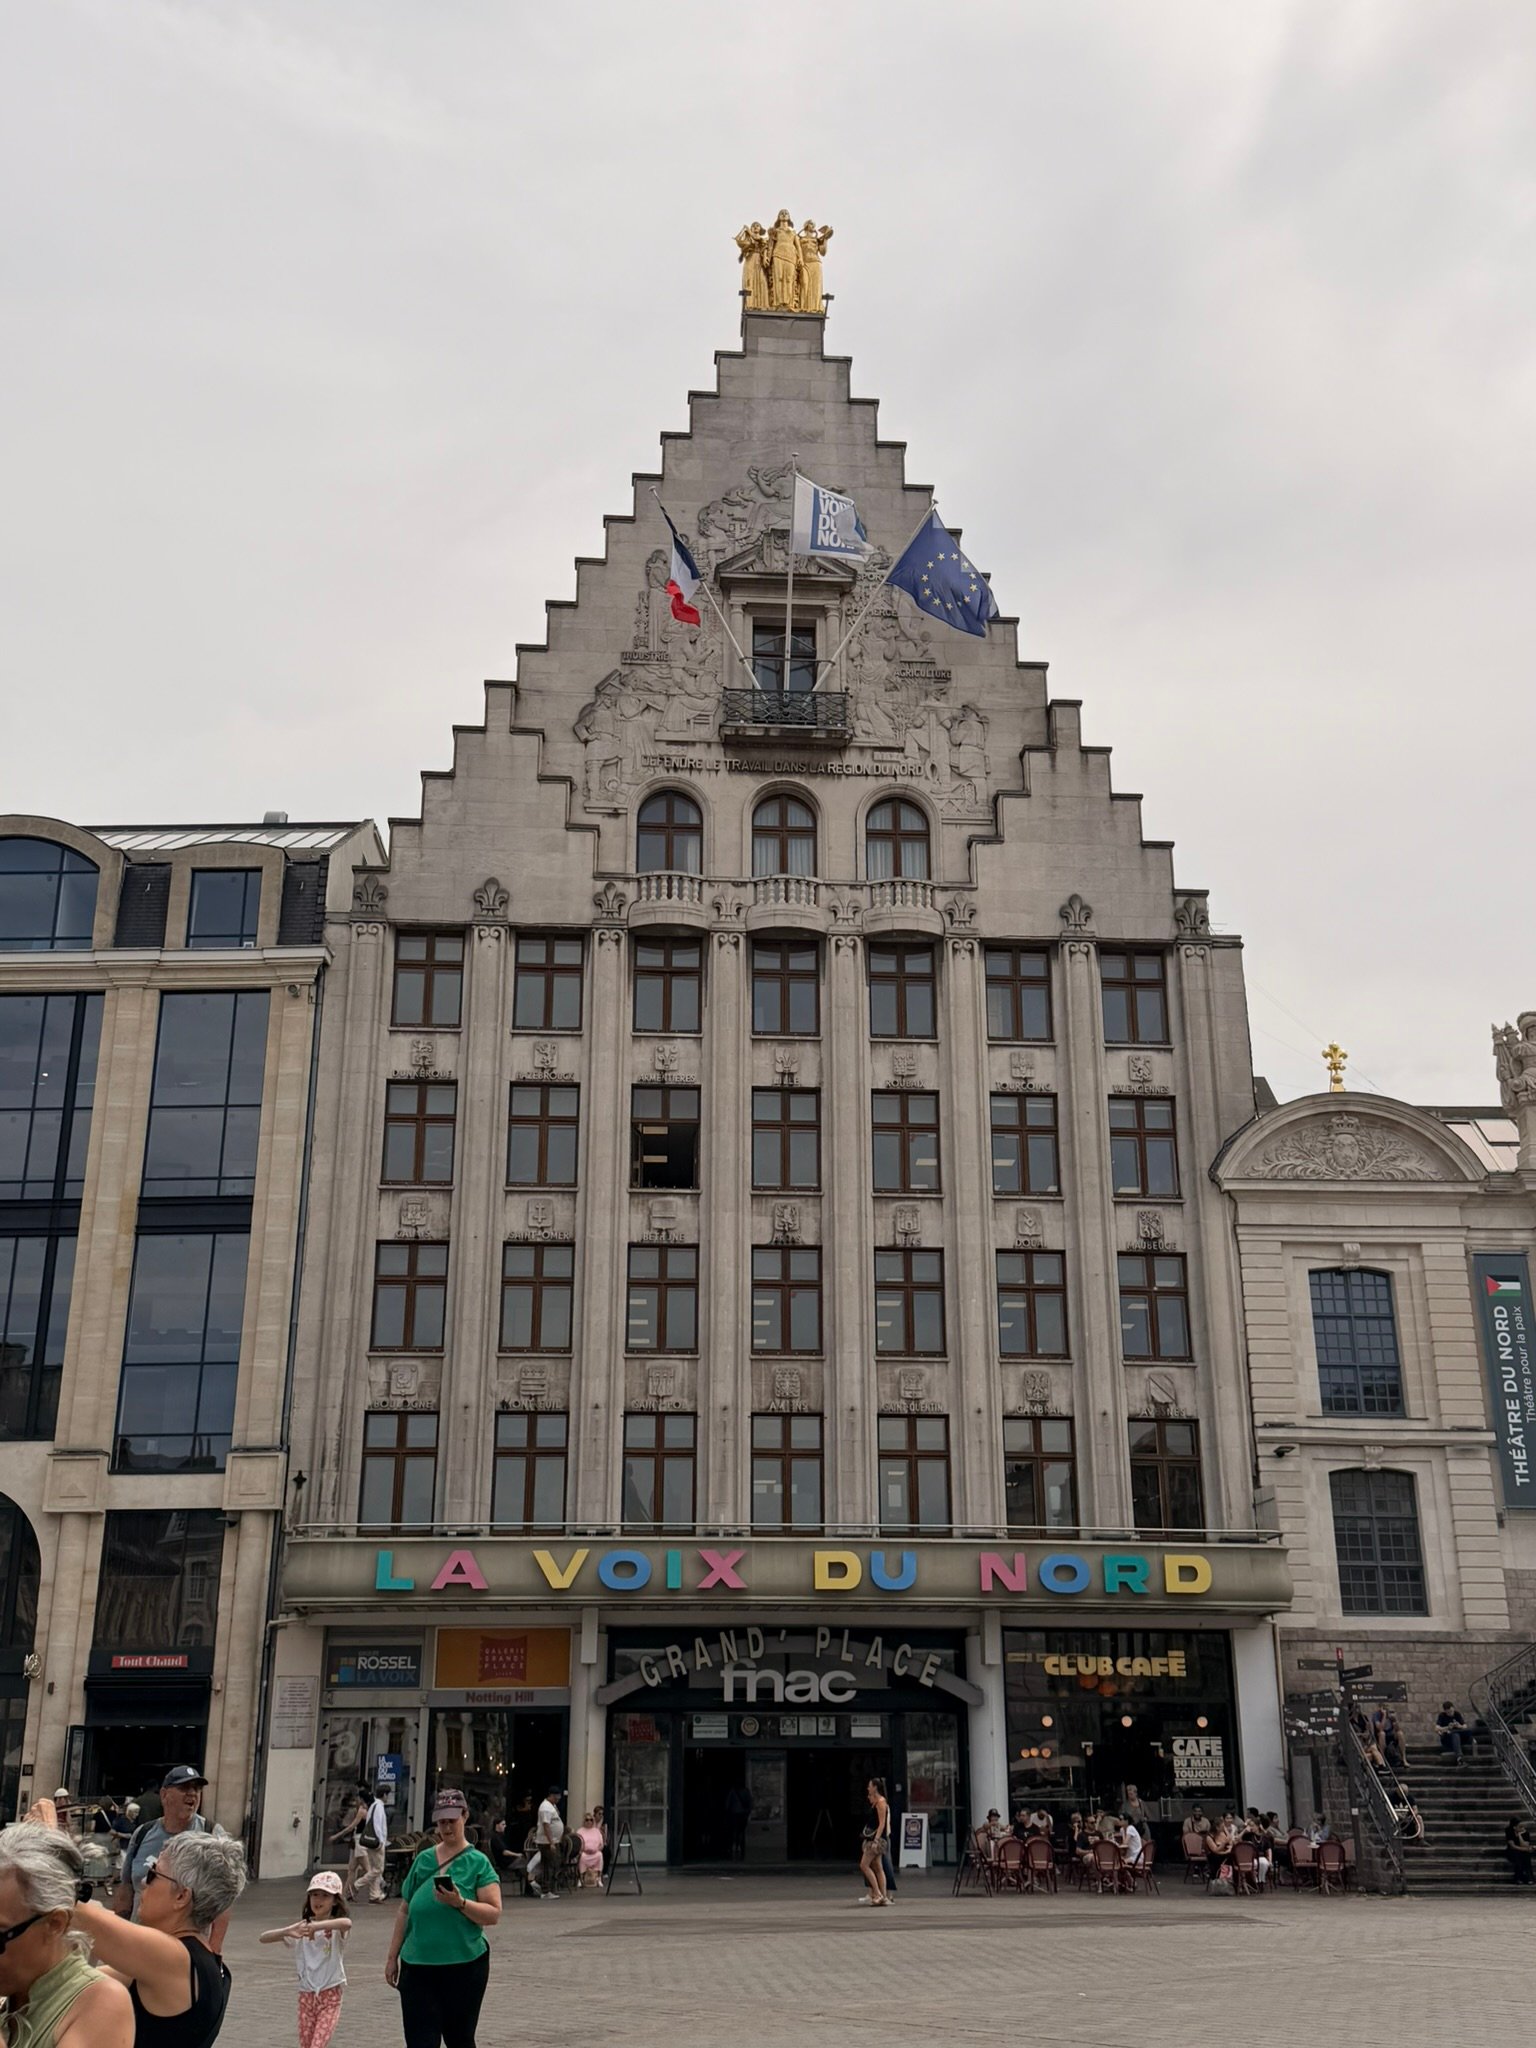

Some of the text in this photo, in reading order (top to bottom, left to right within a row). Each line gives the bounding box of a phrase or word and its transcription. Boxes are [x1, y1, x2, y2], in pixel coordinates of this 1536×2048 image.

[819, 498, 848, 516] VOI
[817, 530, 854, 549] NO
[856, 573, 885, 581] SPOR
[622, 652, 669, 661] INDUSTRIE
[894, 669, 951, 680] AGRICULTURE
[706, 760, 720, 770] LE
[725, 760, 772, 772] TRAVAIL
[774, 761, 806, 773] DANS
[809, 762, 824, 773] LA
[873, 763, 889, 775] DU
[893, 764, 924, 776] NORD
[885, 1079, 926, 1088] ROUBAIX
[995, 1081, 1052, 1091] TOURCOING
[508, 1230, 571, 1240] SAINT-OMER
[1513, 1305, 1536, 1423] Théâtre pour la paix
[1493, 1305, 1530, 1487] THÉÂTRE DU NORD
[375, 1548, 1213, 1594] LA VOIX DU NORD
[119, 1655, 182, 1667] Tout Chaud
[357, 1656, 416, 1670] ROSSEL
[815, 1626, 943, 1688] PLACE
[1043, 1650, 1187, 1678] CLUB CAFÉ
[357, 1671, 416, 1683] LA VOIX
[720, 1657, 857, 1703] fnac
[466, 1691, 534, 1705] Notting Hill
[1172, 1739, 1223, 1756] CAFE
[1173, 1758, 1224, 1767] DU MATIN
[1174, 1770, 1225, 1778] TOUJOURS
